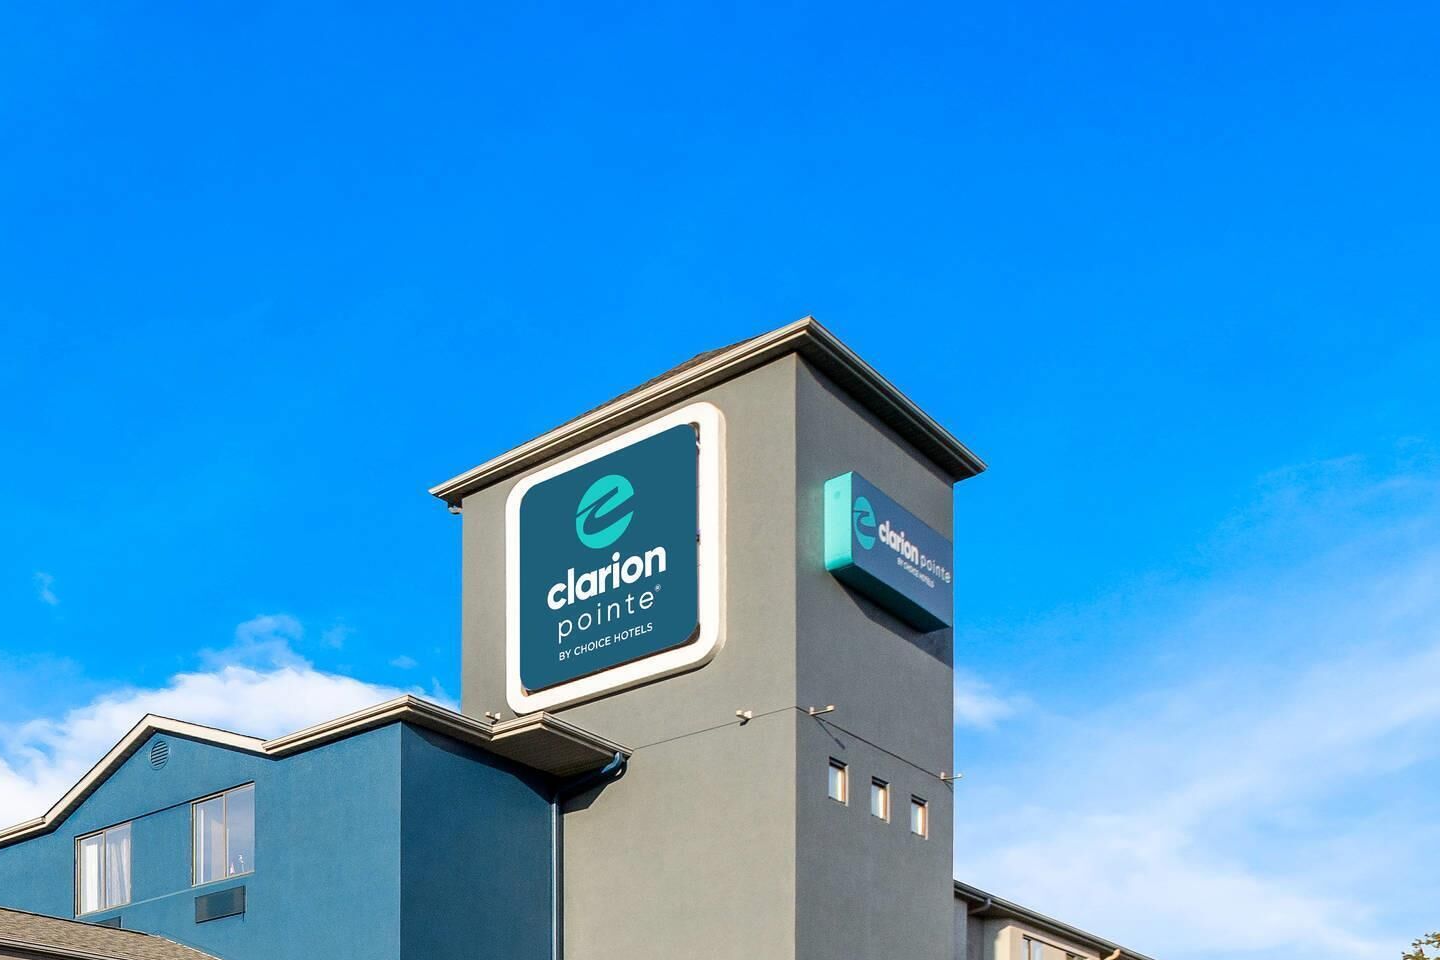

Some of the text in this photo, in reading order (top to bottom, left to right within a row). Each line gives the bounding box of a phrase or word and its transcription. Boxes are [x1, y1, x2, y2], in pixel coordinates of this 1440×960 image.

[547, 546, 666, 610] clarion
[878, 520, 951, 584] clarion pointe
[559, 623, 653, 661] BY CHOICE HOTELS
